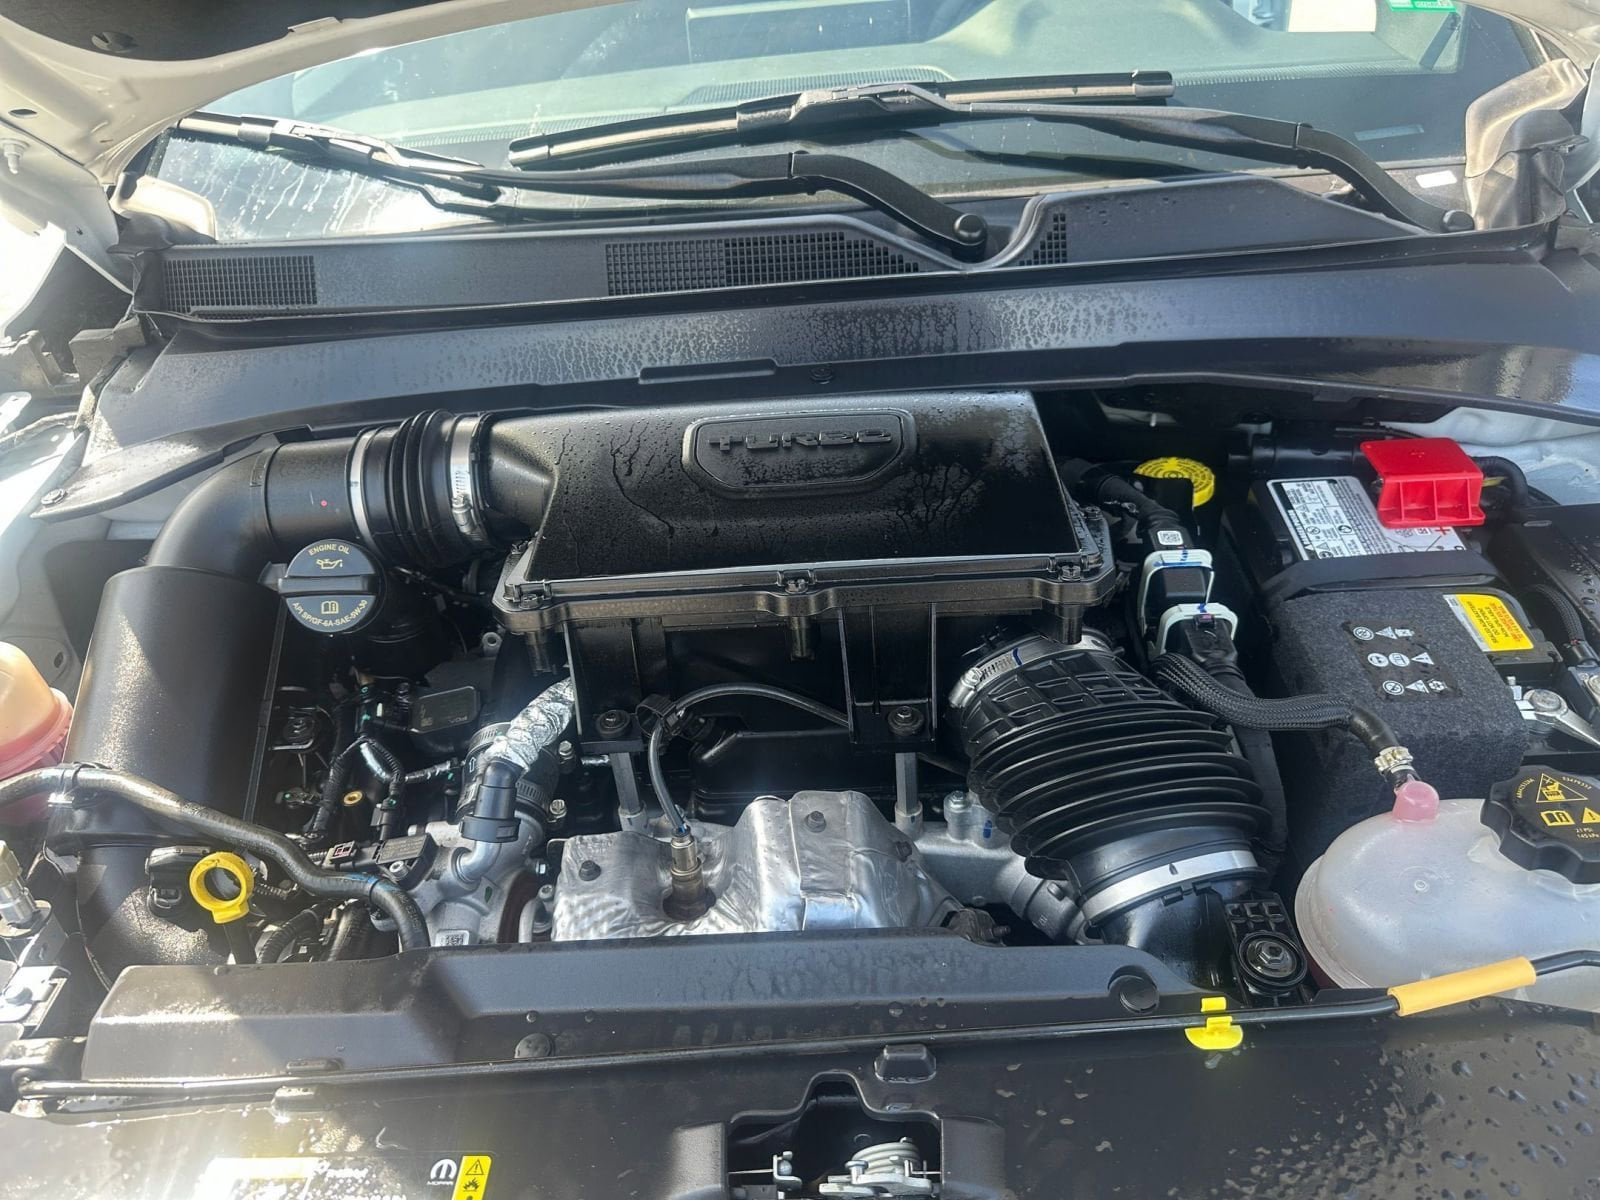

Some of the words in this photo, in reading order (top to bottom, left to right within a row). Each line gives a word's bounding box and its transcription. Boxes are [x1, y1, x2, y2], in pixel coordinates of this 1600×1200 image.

[708, 429, 892, 451] TURBO
[308, 544, 337, 556] ENGINE
[338, 545, 350, 555] OIL
[292, 602, 305, 615] API
